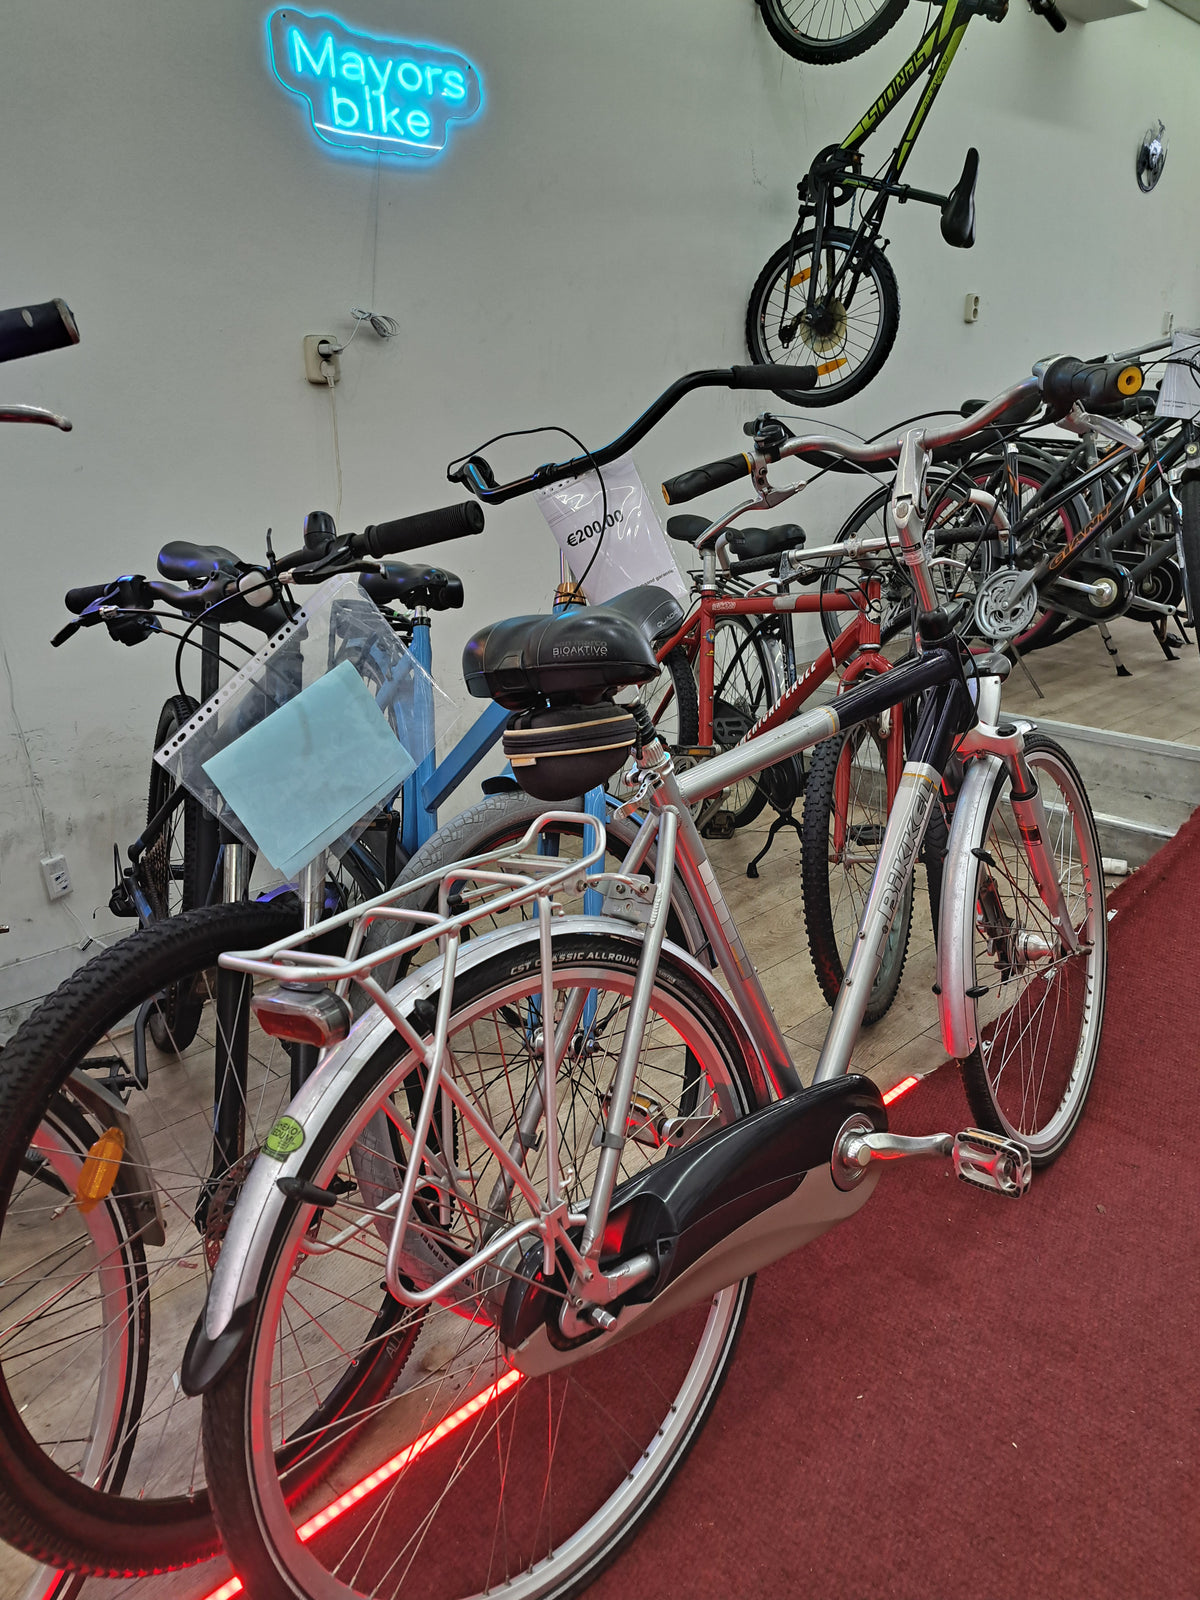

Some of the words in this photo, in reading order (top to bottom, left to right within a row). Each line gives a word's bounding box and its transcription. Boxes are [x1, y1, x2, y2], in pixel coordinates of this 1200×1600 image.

[292, 28, 466, 99] Mayors
[331, 85, 432, 138] bike
[566, 509, 624, 547] €200.00
[1048, 501, 1112, 570] GIANT
[785, 661, 817, 700] EAGLE
[510, 961, 533, 976] CST
[534, 951, 585, 967] CASSIC
[586, 951, 640, 967] ALLROUN
